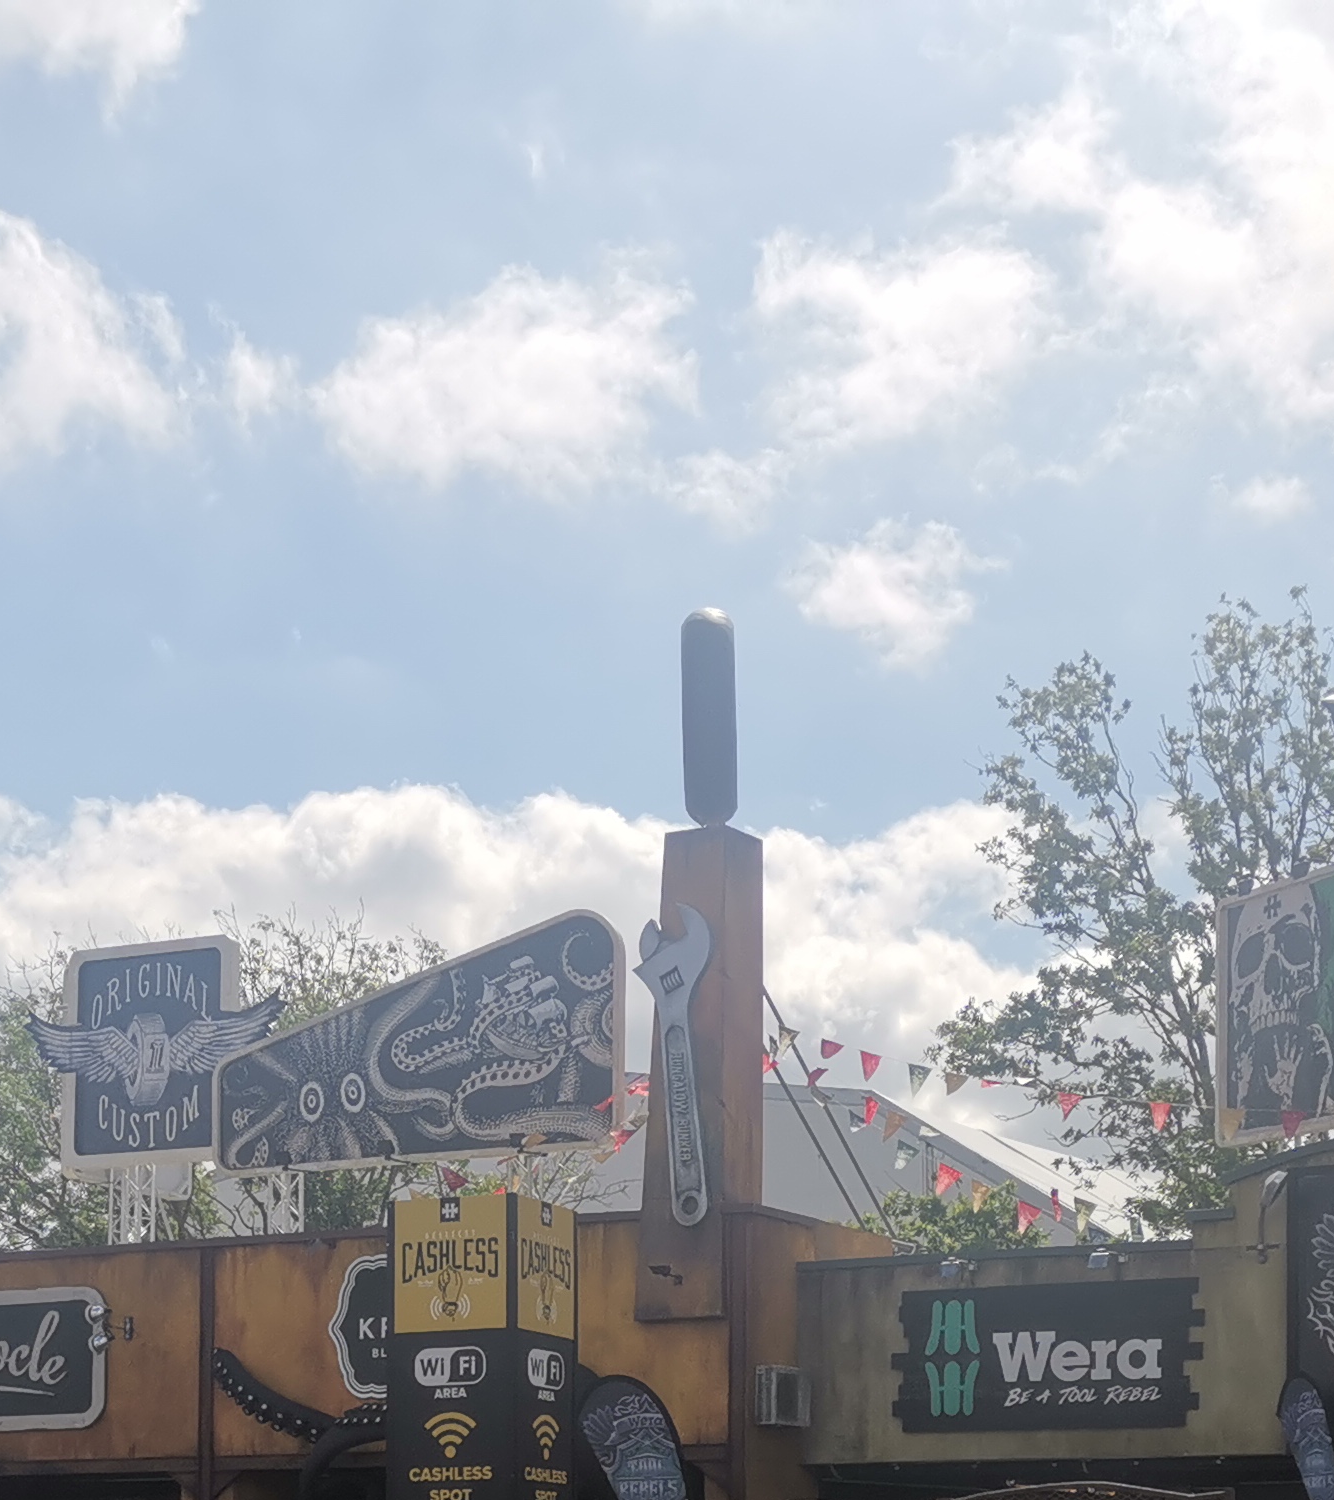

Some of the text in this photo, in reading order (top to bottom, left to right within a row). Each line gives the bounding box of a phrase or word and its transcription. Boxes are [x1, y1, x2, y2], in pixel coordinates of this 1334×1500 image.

[91, 962, 212, 1030] ORIGINAL
[98, 1085, 200, 1149] CUSTOM
[401, 1237, 499, 1284] CASHLESS
[520, 1238, 571, 1290] CASHLESS
[992, 1331, 1163, 1382] Wera
[434, 1388, 467, 1400] AREA
[537, 1390, 556, 1402] AREA
[1003, 1385, 1163, 1408] BE A TOOL REBEL
[408, 1465, 493, 1482] CASHLESS
[524, 1466, 567, 1485] CASHLESS
